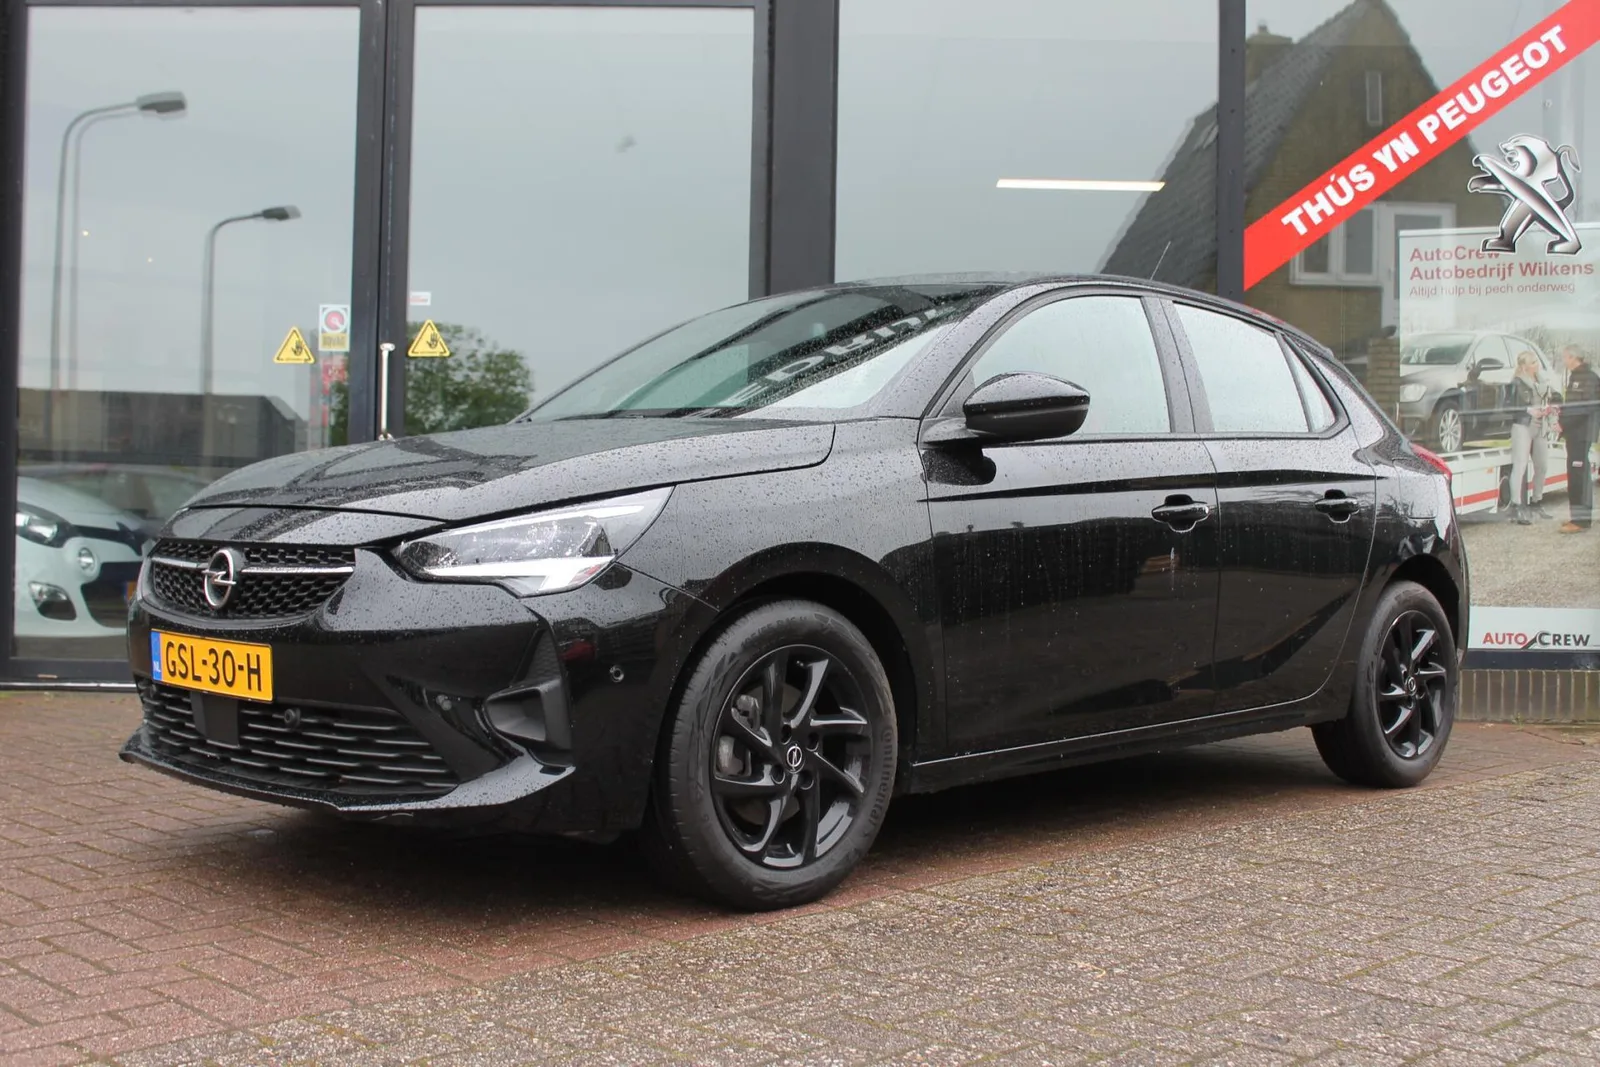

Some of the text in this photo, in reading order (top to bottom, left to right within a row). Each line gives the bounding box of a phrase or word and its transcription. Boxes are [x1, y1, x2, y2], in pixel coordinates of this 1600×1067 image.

[1281, 25, 1567, 236] THÚS YN PEUGEOT
[1409, 245, 1500, 262] AutoCrew
[1409, 261, 1594, 281] Autobedrijf Wilkens
[1409, 281, 1575, 298] Altijd hulp bij pech onderweg
[1482, 631, 1590, 647] AUTO CREW
[165, 641, 263, 692] GSL-30-H
